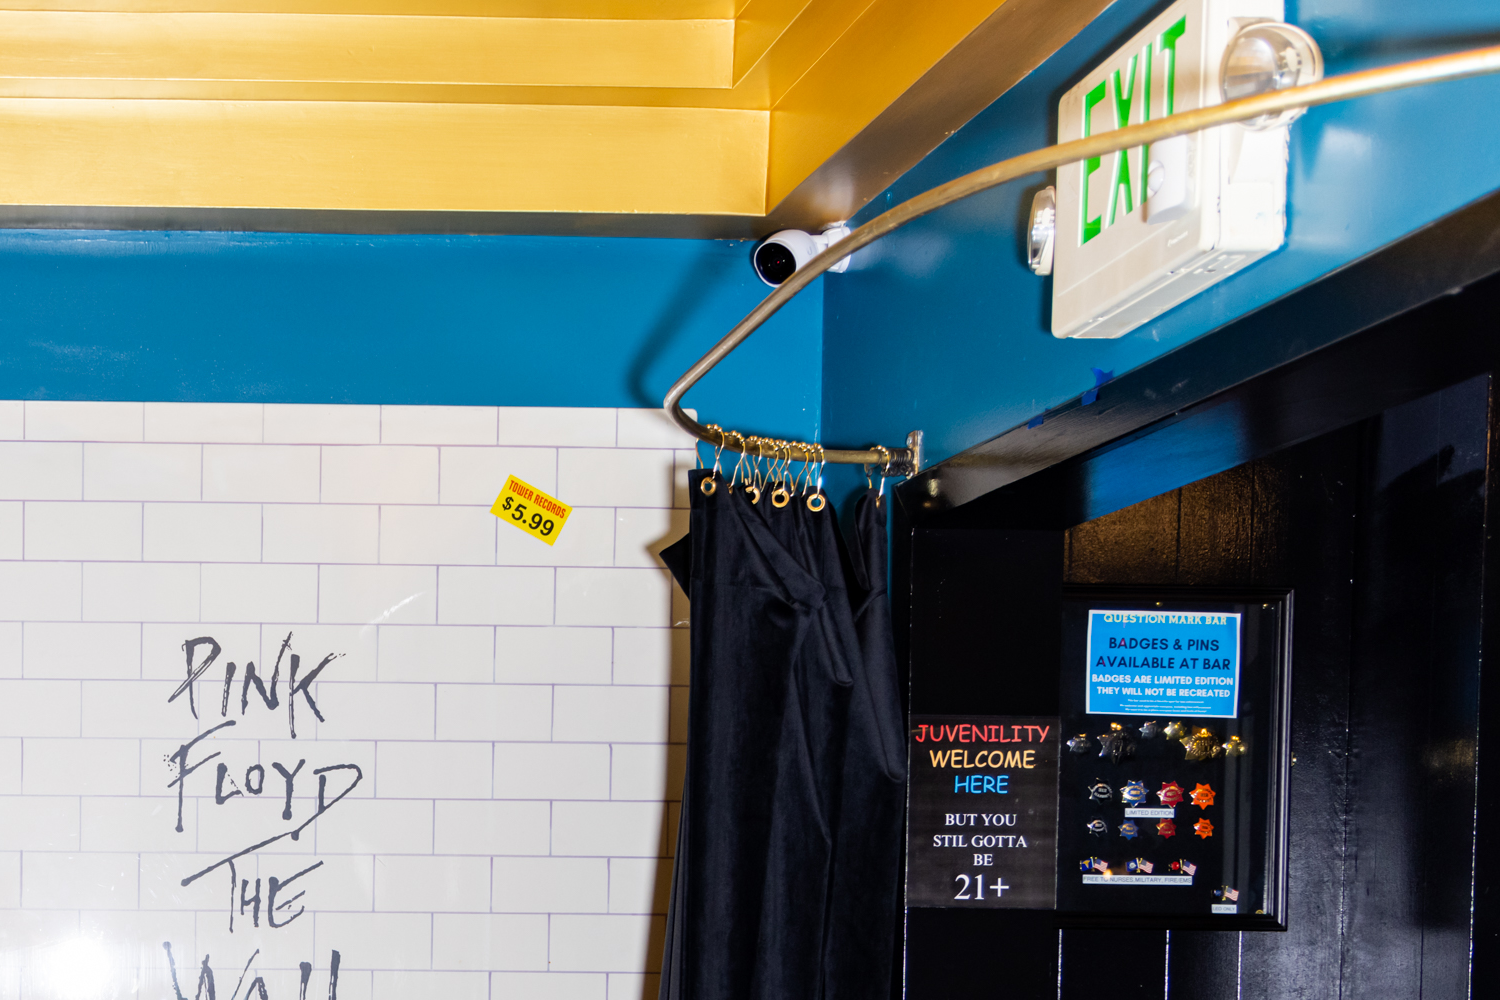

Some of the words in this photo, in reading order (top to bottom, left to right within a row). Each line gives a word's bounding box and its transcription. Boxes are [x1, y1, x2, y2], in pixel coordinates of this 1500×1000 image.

[1078, 14, 1187, 248] EXIT
[508, 479, 534, 502] TOWER
[533, 494, 567, 519] RECORDS
[502, 496, 555, 537] $5.99
[1103, 614, 1166, 624] QUESTION
[1168, 615, 1202, 625] MARK
[1205, 616, 1227, 625] BAR
[1109, 637, 1169, 650] BADGES
[1172, 638, 1183, 651] &
[1187, 639, 1220, 652] PINS
[1095, 655, 1175, 669] AVAILABLE
[1179, 657, 1199, 669] AT
[1202, 658, 1231, 670] BAR
[167, 631, 347, 740] PINK
[1092, 673, 1131, 684] BADGES
[1133, 675, 1152, 684] ARE
[1154, 675, 1193, 685] LIMITED
[1195, 676, 1234, 686] EDITION
[1096, 686, 1120, 695] THEY
[1121, 687, 1142, 696] WILL
[1144, 688, 1165, 696] NOT
[1166, 688, 1177, 697] BE
[1179, 688, 1231, 698] RECREATED
[915, 723, 1050, 743] JUVENILITY
[929, 749, 1036, 769] WELCOME
[164, 720, 363, 836] FLOYD
[954, 774, 1009, 794] HERE
[945, 813, 978, 827] BUT
[981, 813, 1017, 827] YOU
[933, 834, 968, 848] STIL
[971, 834, 1028, 848] GOTTA
[973, 853, 994, 866] BE
[180, 831, 325, 934] THE
[954, 873, 1010, 900] 21+
